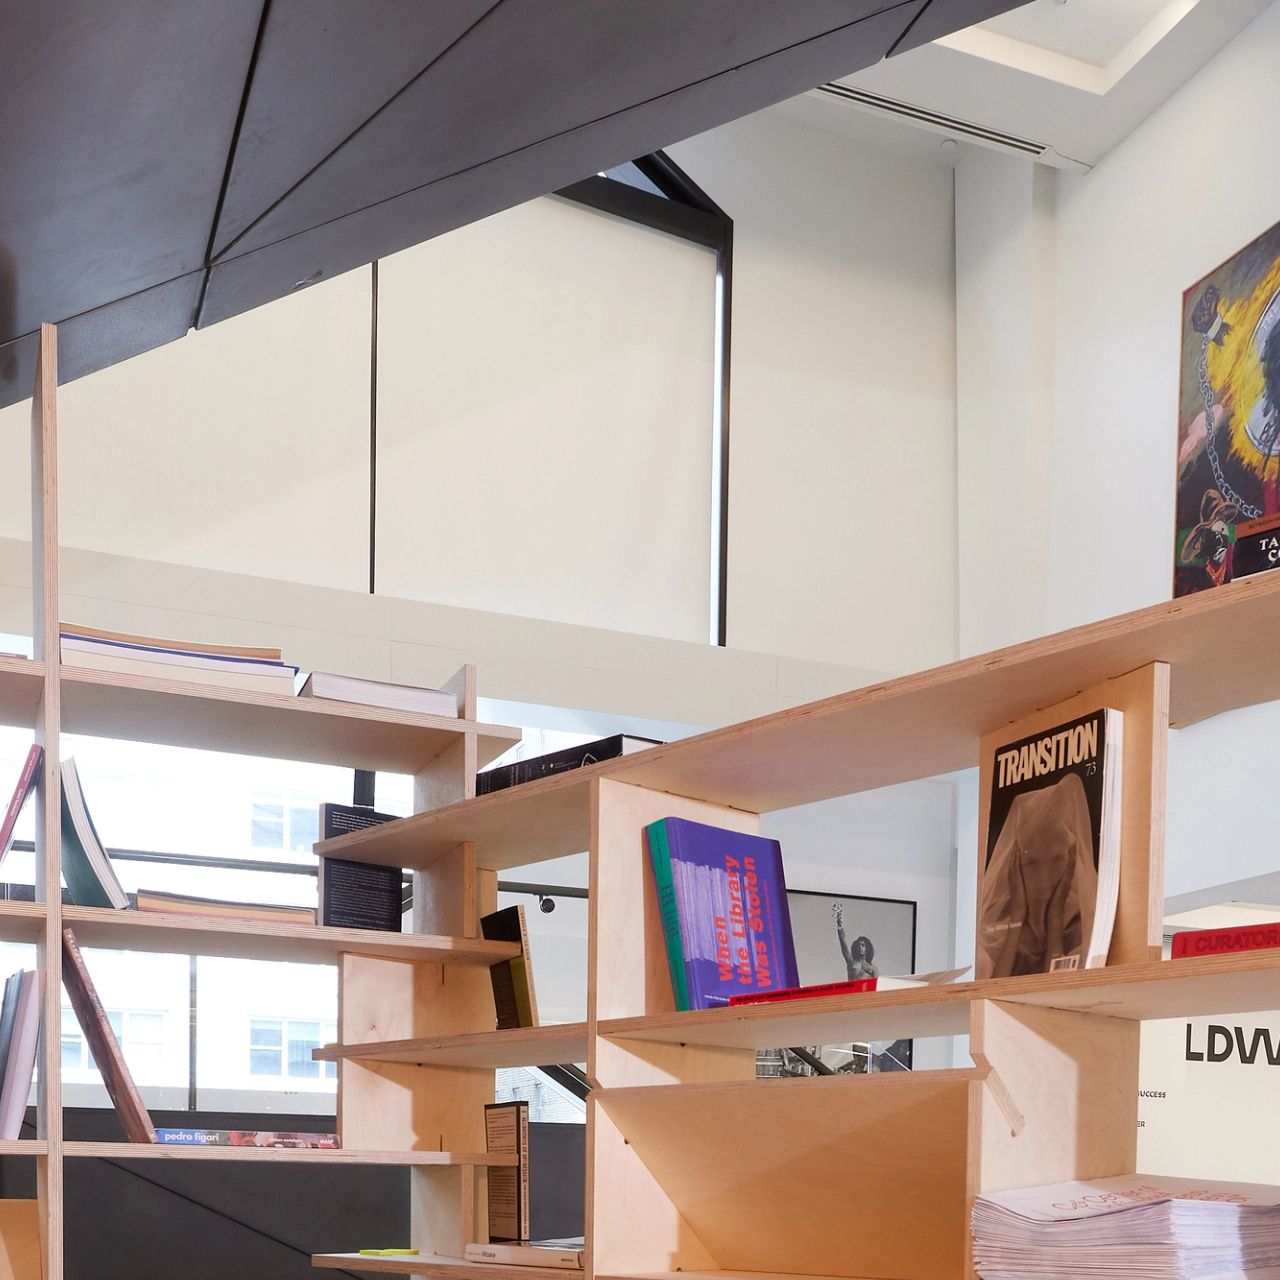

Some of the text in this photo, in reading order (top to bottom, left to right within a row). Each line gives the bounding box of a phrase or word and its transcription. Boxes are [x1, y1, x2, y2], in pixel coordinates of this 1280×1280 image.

[997, 719, 1098, 788] TRANSITION
[1086, 763, 1097, 777] 73
[714, 916, 734, 982] When
[725, 856, 753, 985] the Library
[744, 857, 772, 988] Was Stolen
[164, 1131, 193, 1142] pedro
[194, 1131, 219, 1143] figari
